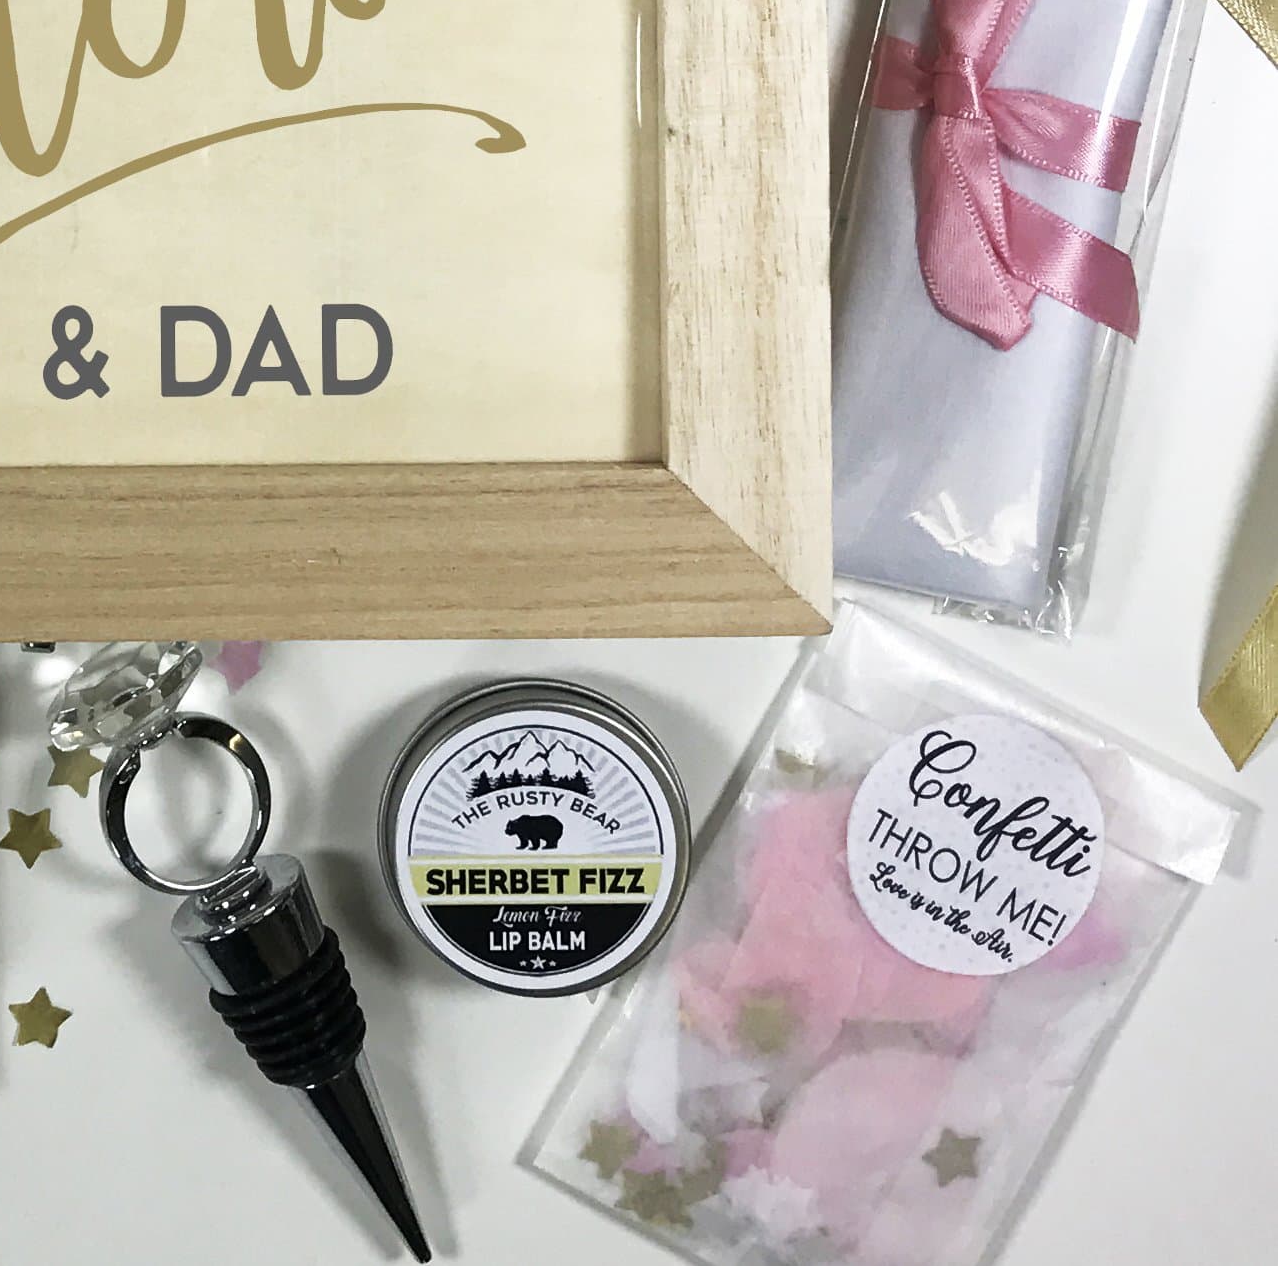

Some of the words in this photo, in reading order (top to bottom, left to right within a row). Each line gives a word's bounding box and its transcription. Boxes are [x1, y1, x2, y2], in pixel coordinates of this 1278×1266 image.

[42, 305, 110, 401] &
[161, 304, 393, 398] DAD
[451, 800, 492, 829] THE
[495, 790, 565, 810] RUSTY
[569, 797, 621, 835] BEAR
[908, 730, 1098, 878] Confetti
[426, 868, 570, 896] SHERBET
[579, 867, 645, 895] FIZZ
[868, 808, 999, 903] THROW
[996, 887, 1067, 946] ME!
[869, 861, 911, 900] Love
[909, 891, 926, 911] is
[924, 900, 945, 922] in
[943, 905, 972, 935] the
[970, 928, 1013, 963] Air.
[489, 931, 522, 951] LIP
[528, 930, 586, 951] BALM
[492, 905, 539, 928] Lemon
